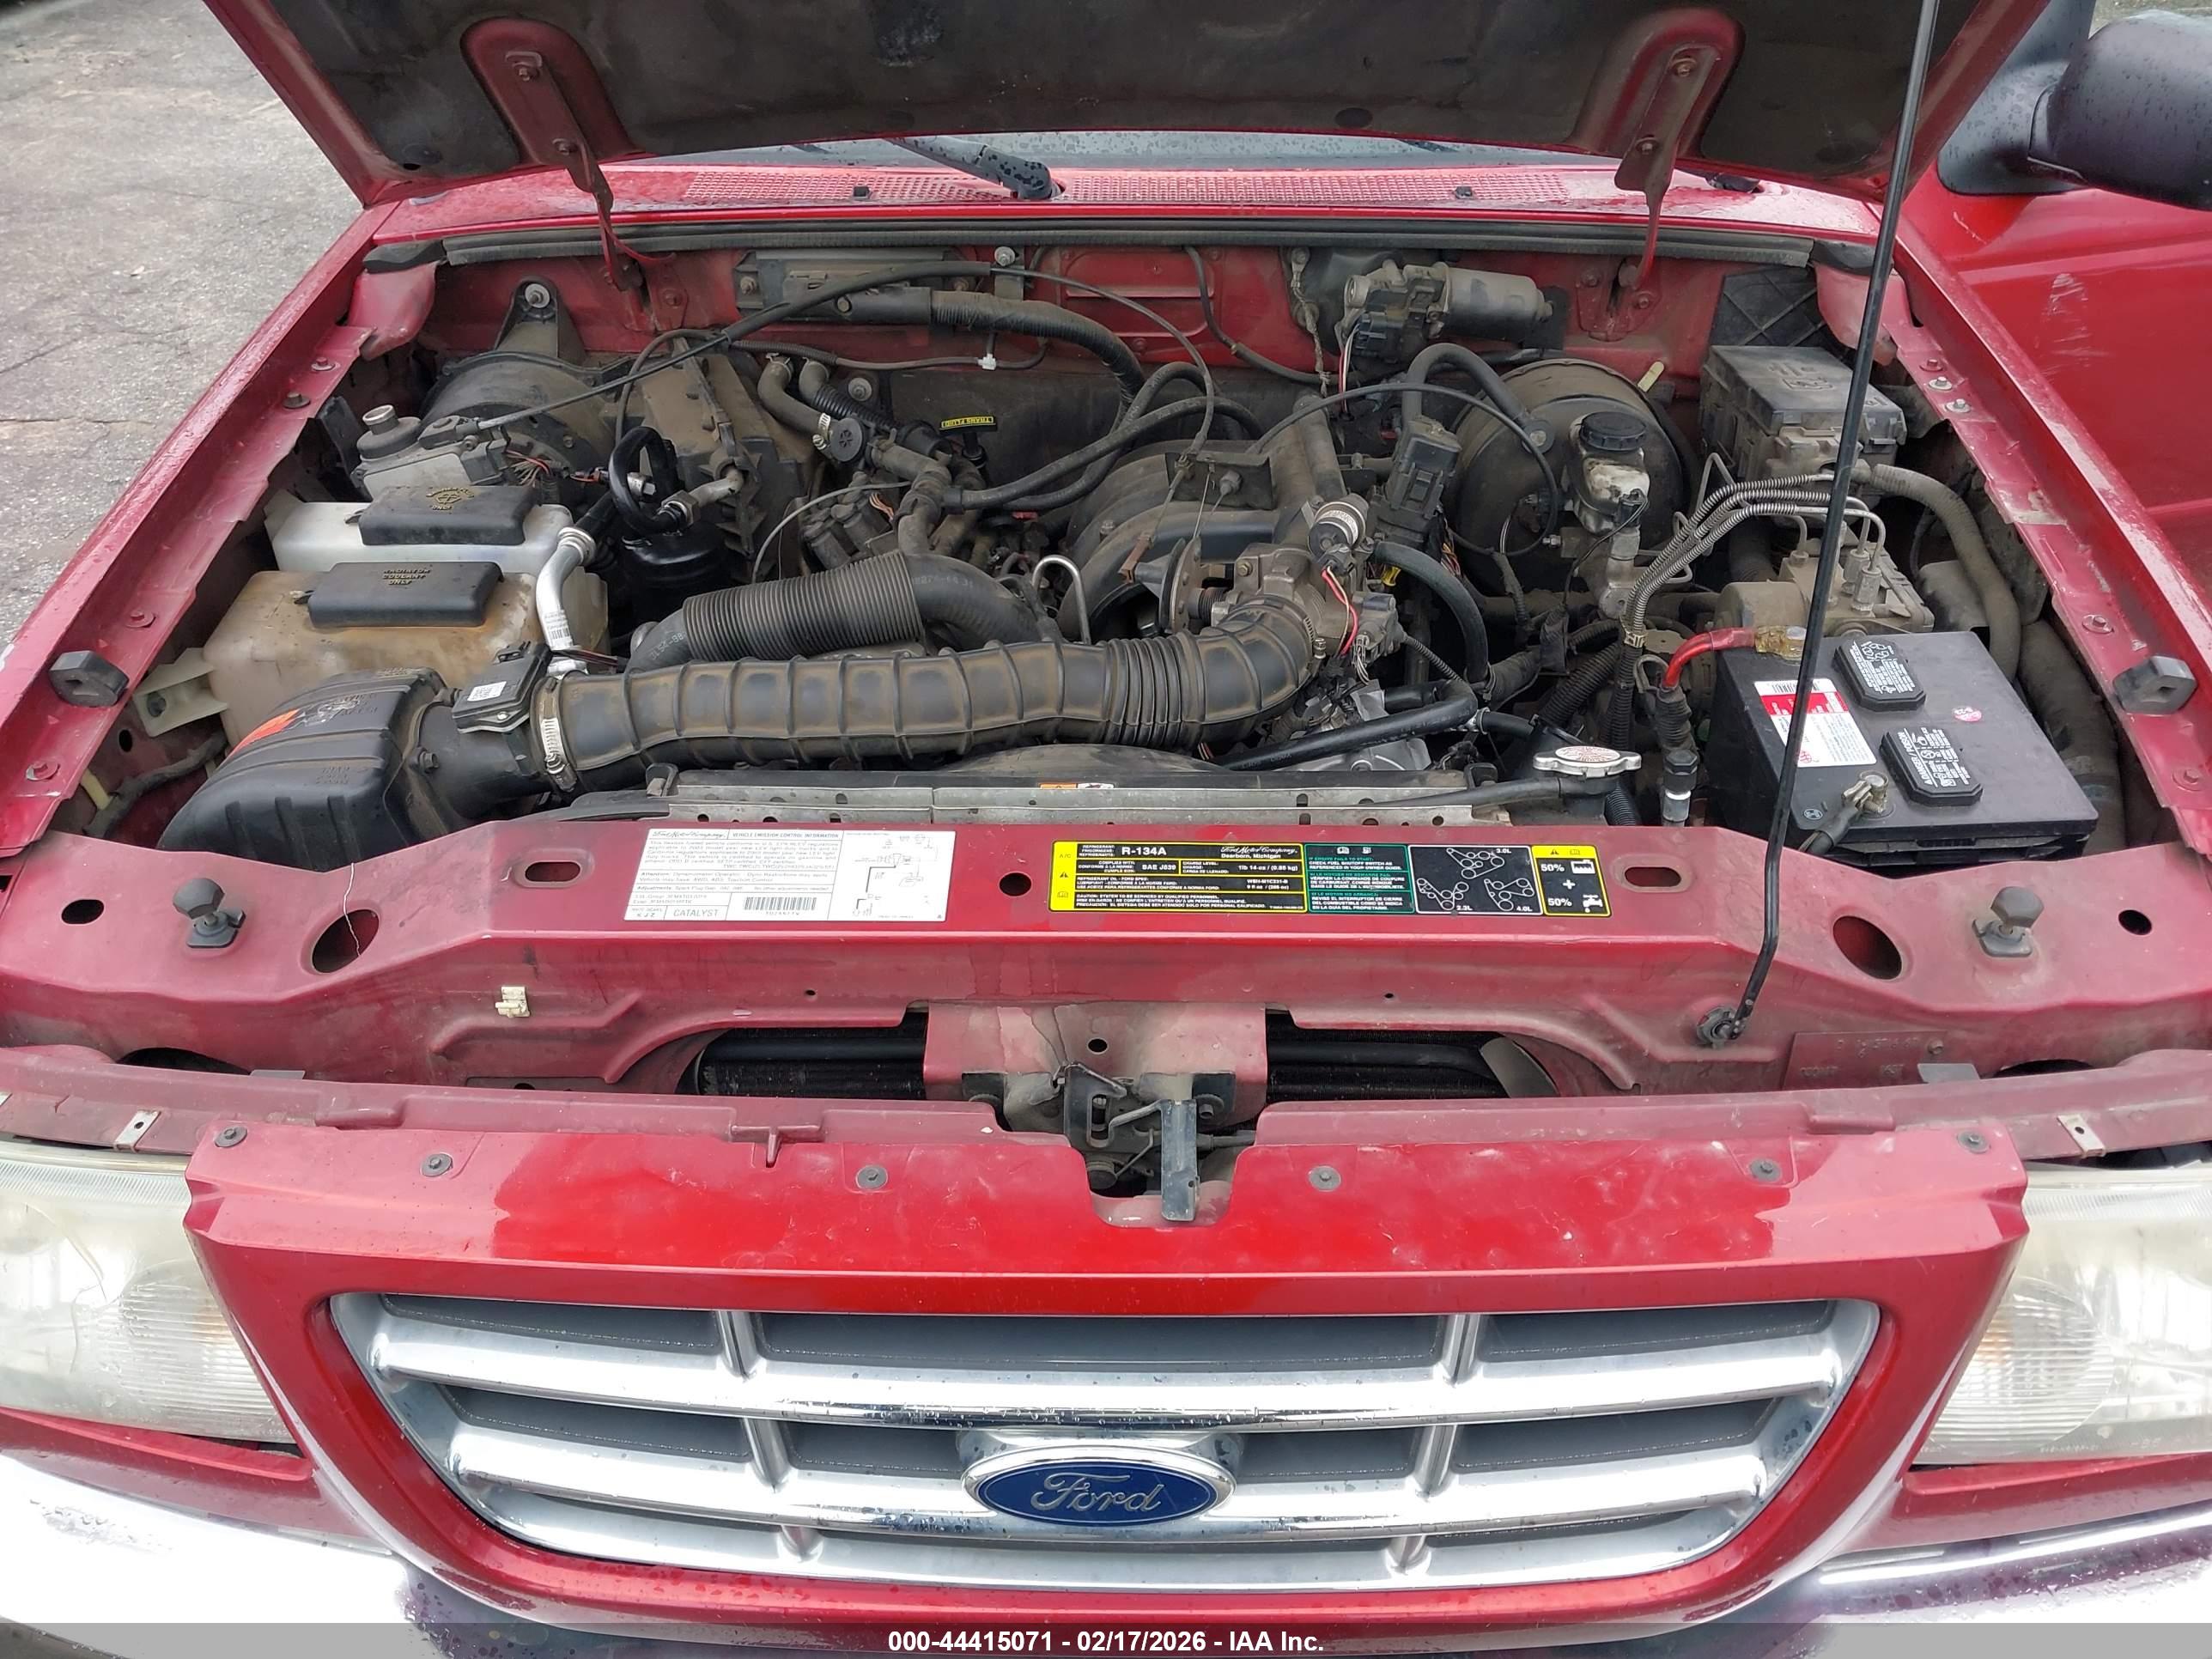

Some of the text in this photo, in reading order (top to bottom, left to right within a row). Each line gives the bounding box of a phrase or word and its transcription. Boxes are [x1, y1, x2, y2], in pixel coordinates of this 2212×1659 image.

[1121, 847, 1167, 856] R-134A
[1540, 864, 1565, 872] 50%
[1548, 898, 1572, 907] 50%
[673, 908, 719, 917] CATALYST
[1030, 1472, 1164, 1512] Ford
